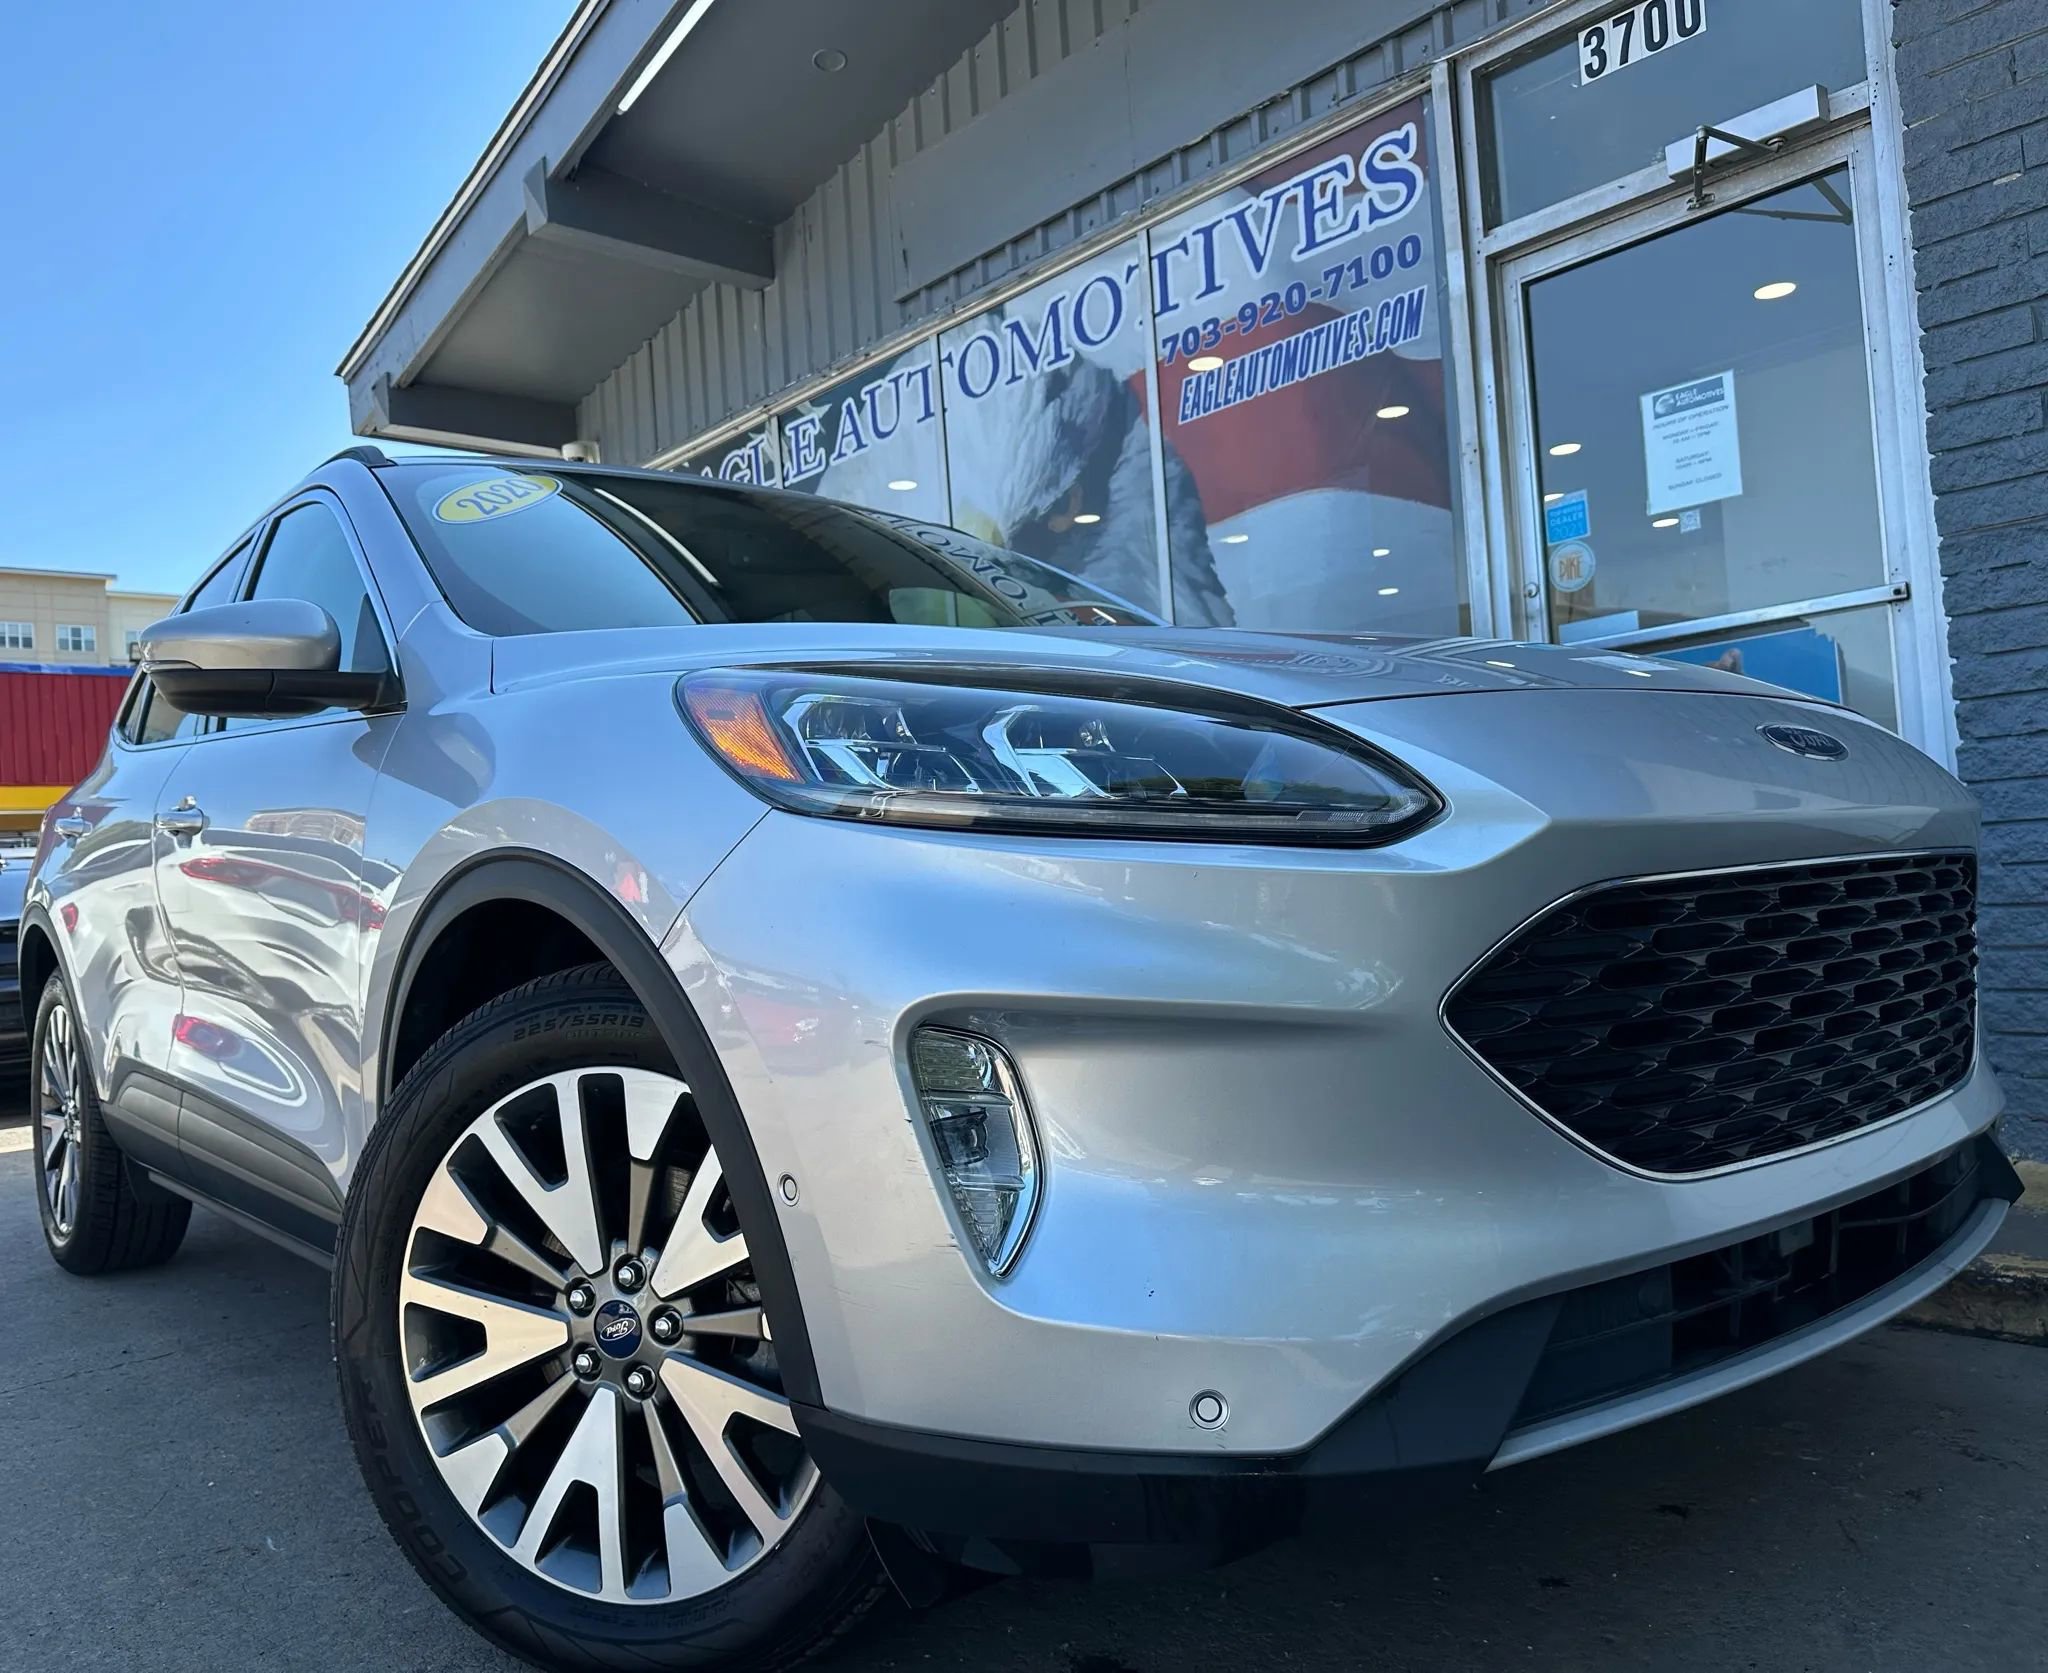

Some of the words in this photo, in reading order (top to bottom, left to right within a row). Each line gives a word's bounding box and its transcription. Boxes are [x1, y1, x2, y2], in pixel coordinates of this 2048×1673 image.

[1583, 0, 1702, 79] 3700
[830, 121, 1424, 464] AUTOMOTIVES
[1161, 233, 1422, 366] 703-920-7100
[1178, 285, 1427, 425] EAGLEAUTOMOTIVES.COM
[455, 478, 544, 516] 2020
[513, 1013, 646, 1041] 225/55R19
[605, 1320, 629, 1338] Ford
